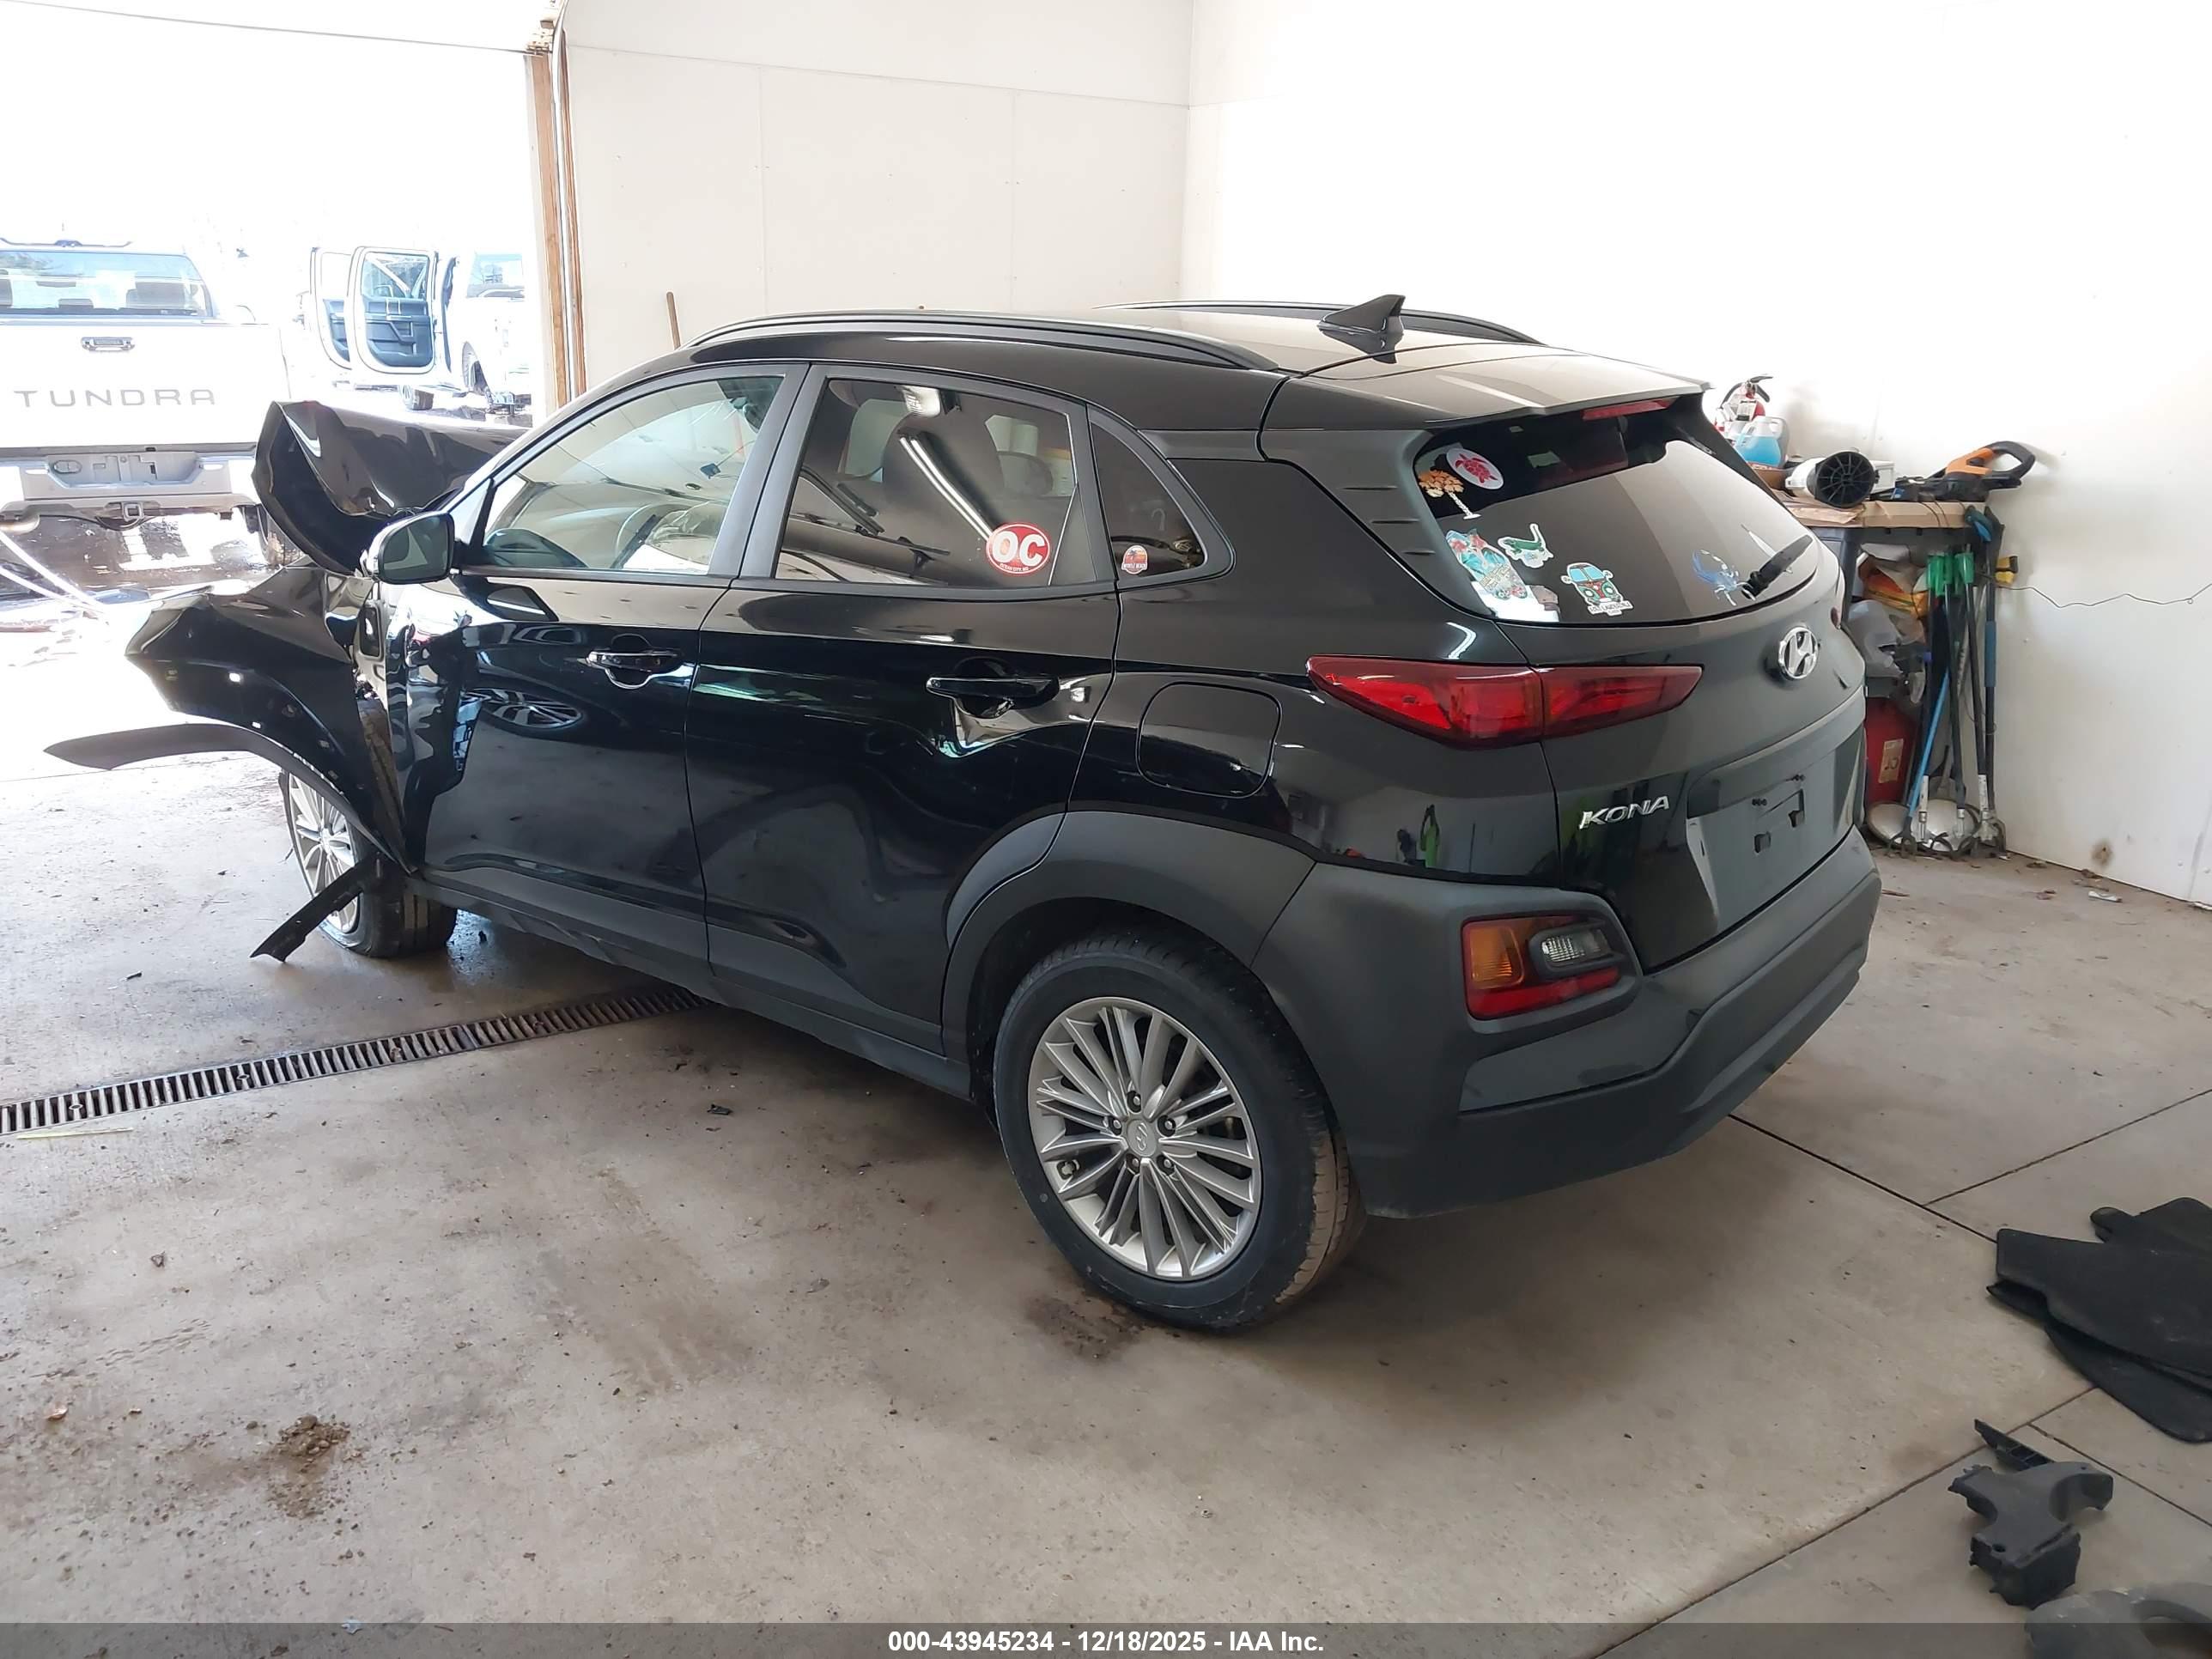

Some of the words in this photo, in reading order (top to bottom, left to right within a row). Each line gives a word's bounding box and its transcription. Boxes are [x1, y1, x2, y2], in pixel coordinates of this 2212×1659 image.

[13, 389, 216, 408] TUNDRA
[992, 531, 1045, 567] OC
[1579, 796, 1669, 830] KONA
